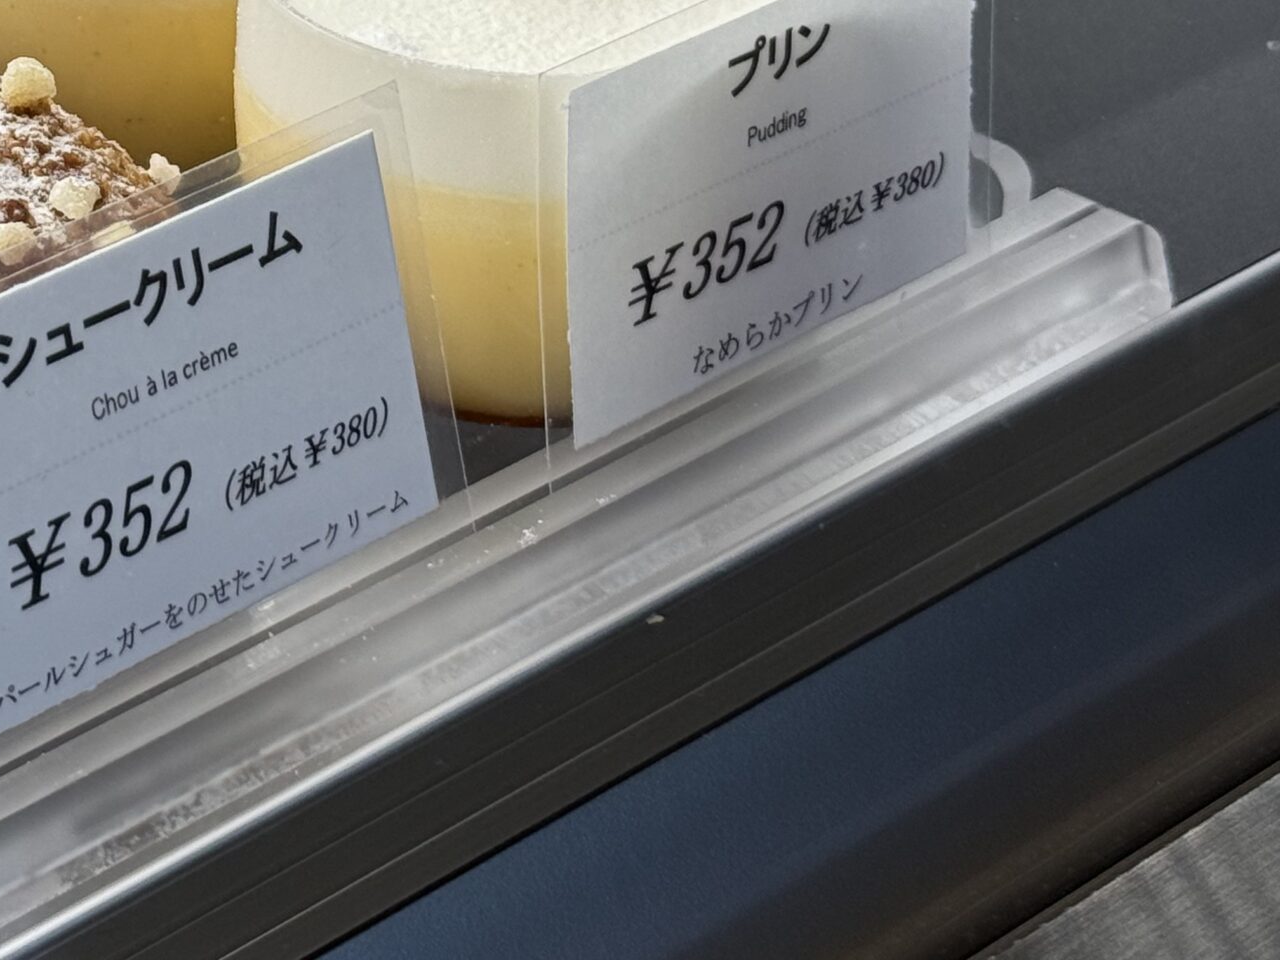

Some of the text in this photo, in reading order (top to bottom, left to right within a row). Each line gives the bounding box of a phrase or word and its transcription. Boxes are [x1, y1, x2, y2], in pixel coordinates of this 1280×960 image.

[728, 23, 831, 98] プリン
[747, 107, 808, 147] Pudding
[628, 200, 786, 327] ¥352
[693, 275, 863, 375] なめらかプリン
[91, 341, 239, 421] Chou à la crème
[8, 460, 193, 611] ¥352
